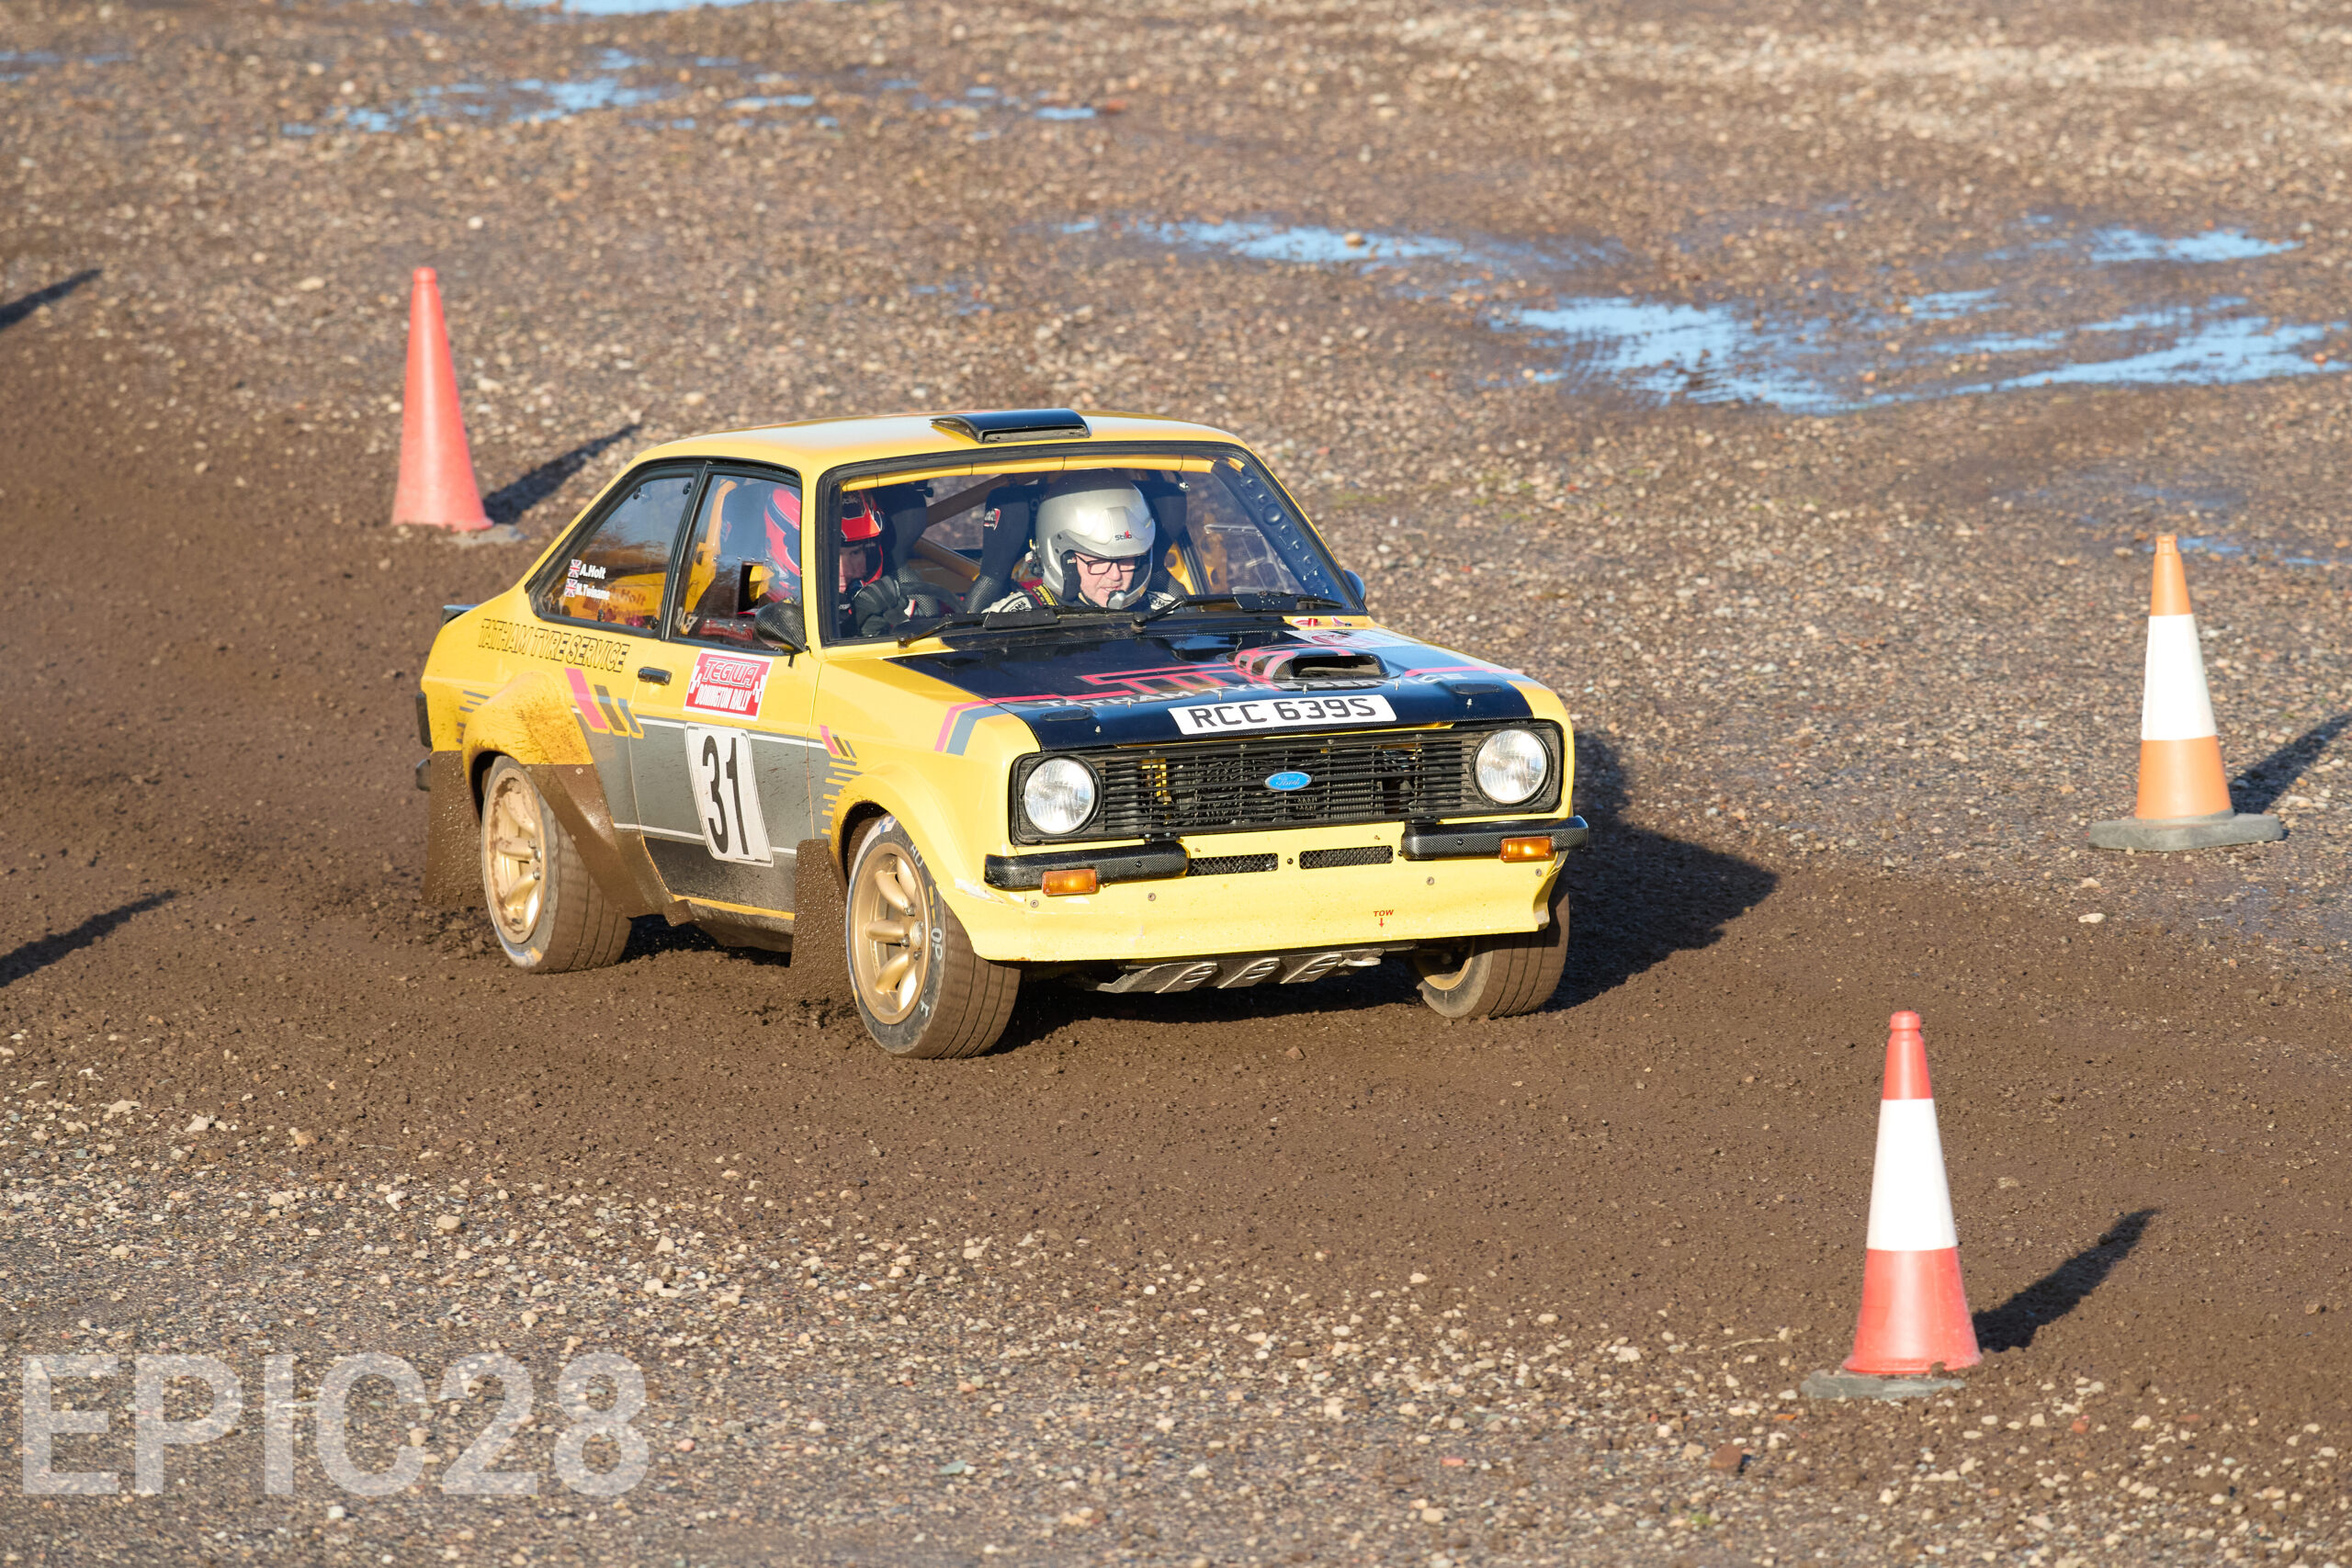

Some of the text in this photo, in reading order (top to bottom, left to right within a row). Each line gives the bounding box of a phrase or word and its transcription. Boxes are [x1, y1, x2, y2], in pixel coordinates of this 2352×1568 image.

[579, 563, 606, 580] A.Holt
[478, 618, 631, 673] TATHAM TYRE SERVICE
[729, 688, 754, 712] RALLY
[1037, 689, 1195, 707] TATHAM
[1188, 698, 1377, 728] RCC 639S
[702, 735, 750, 855] 31
